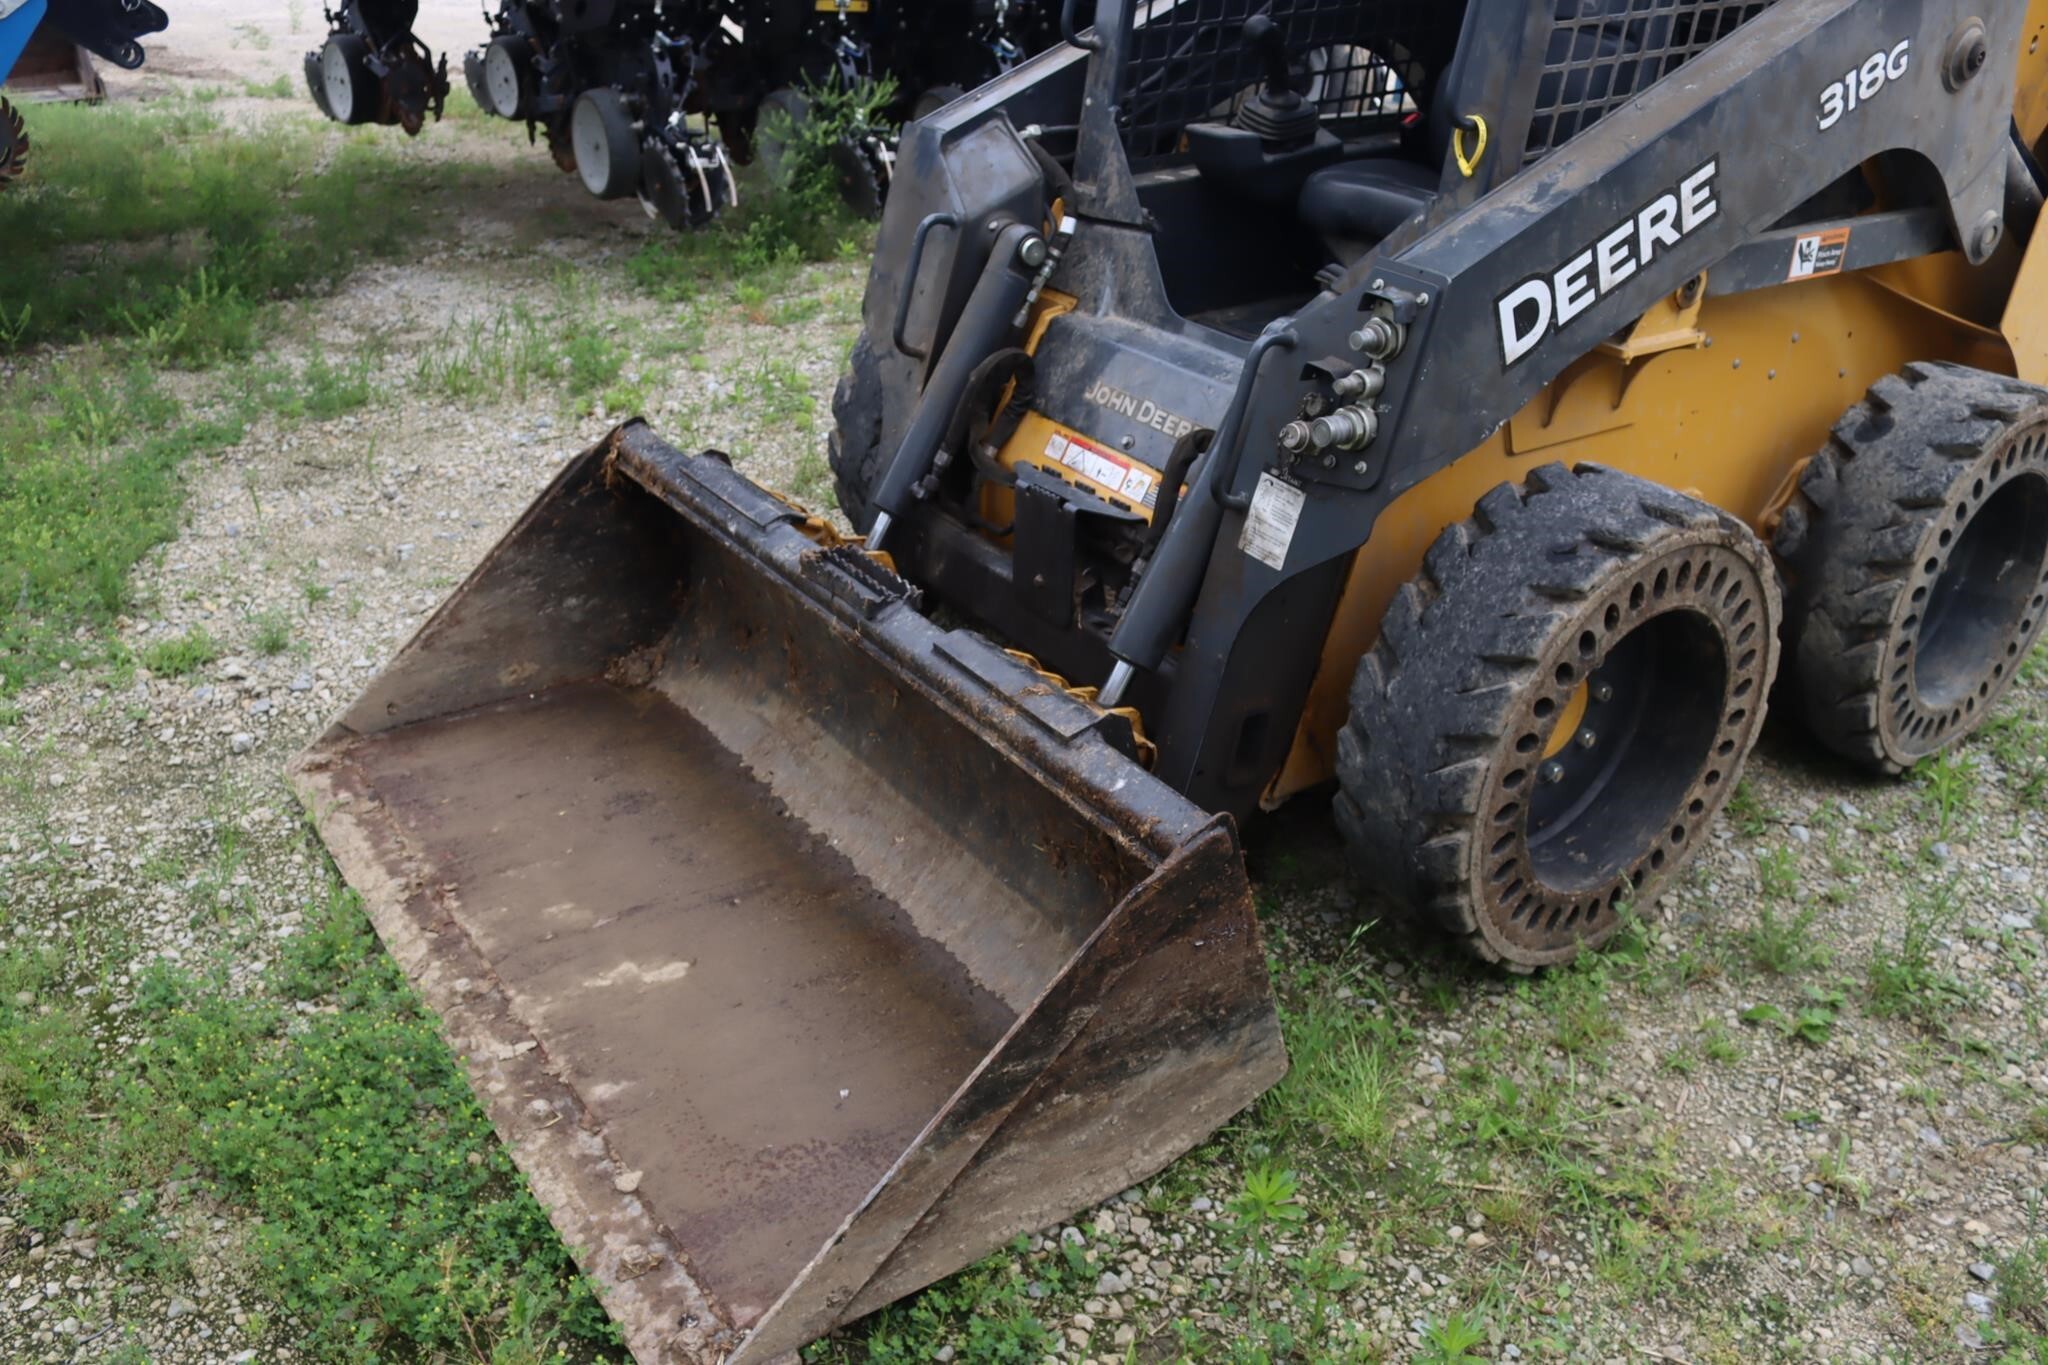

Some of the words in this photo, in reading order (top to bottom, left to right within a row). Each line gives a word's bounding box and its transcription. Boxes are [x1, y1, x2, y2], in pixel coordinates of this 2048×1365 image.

[1819, 39, 1909, 130] 318G
[1499, 161, 1718, 365] DEERE
[1084, 381, 1138, 417] JOHN
[1136, 400, 1203, 438] DEER
